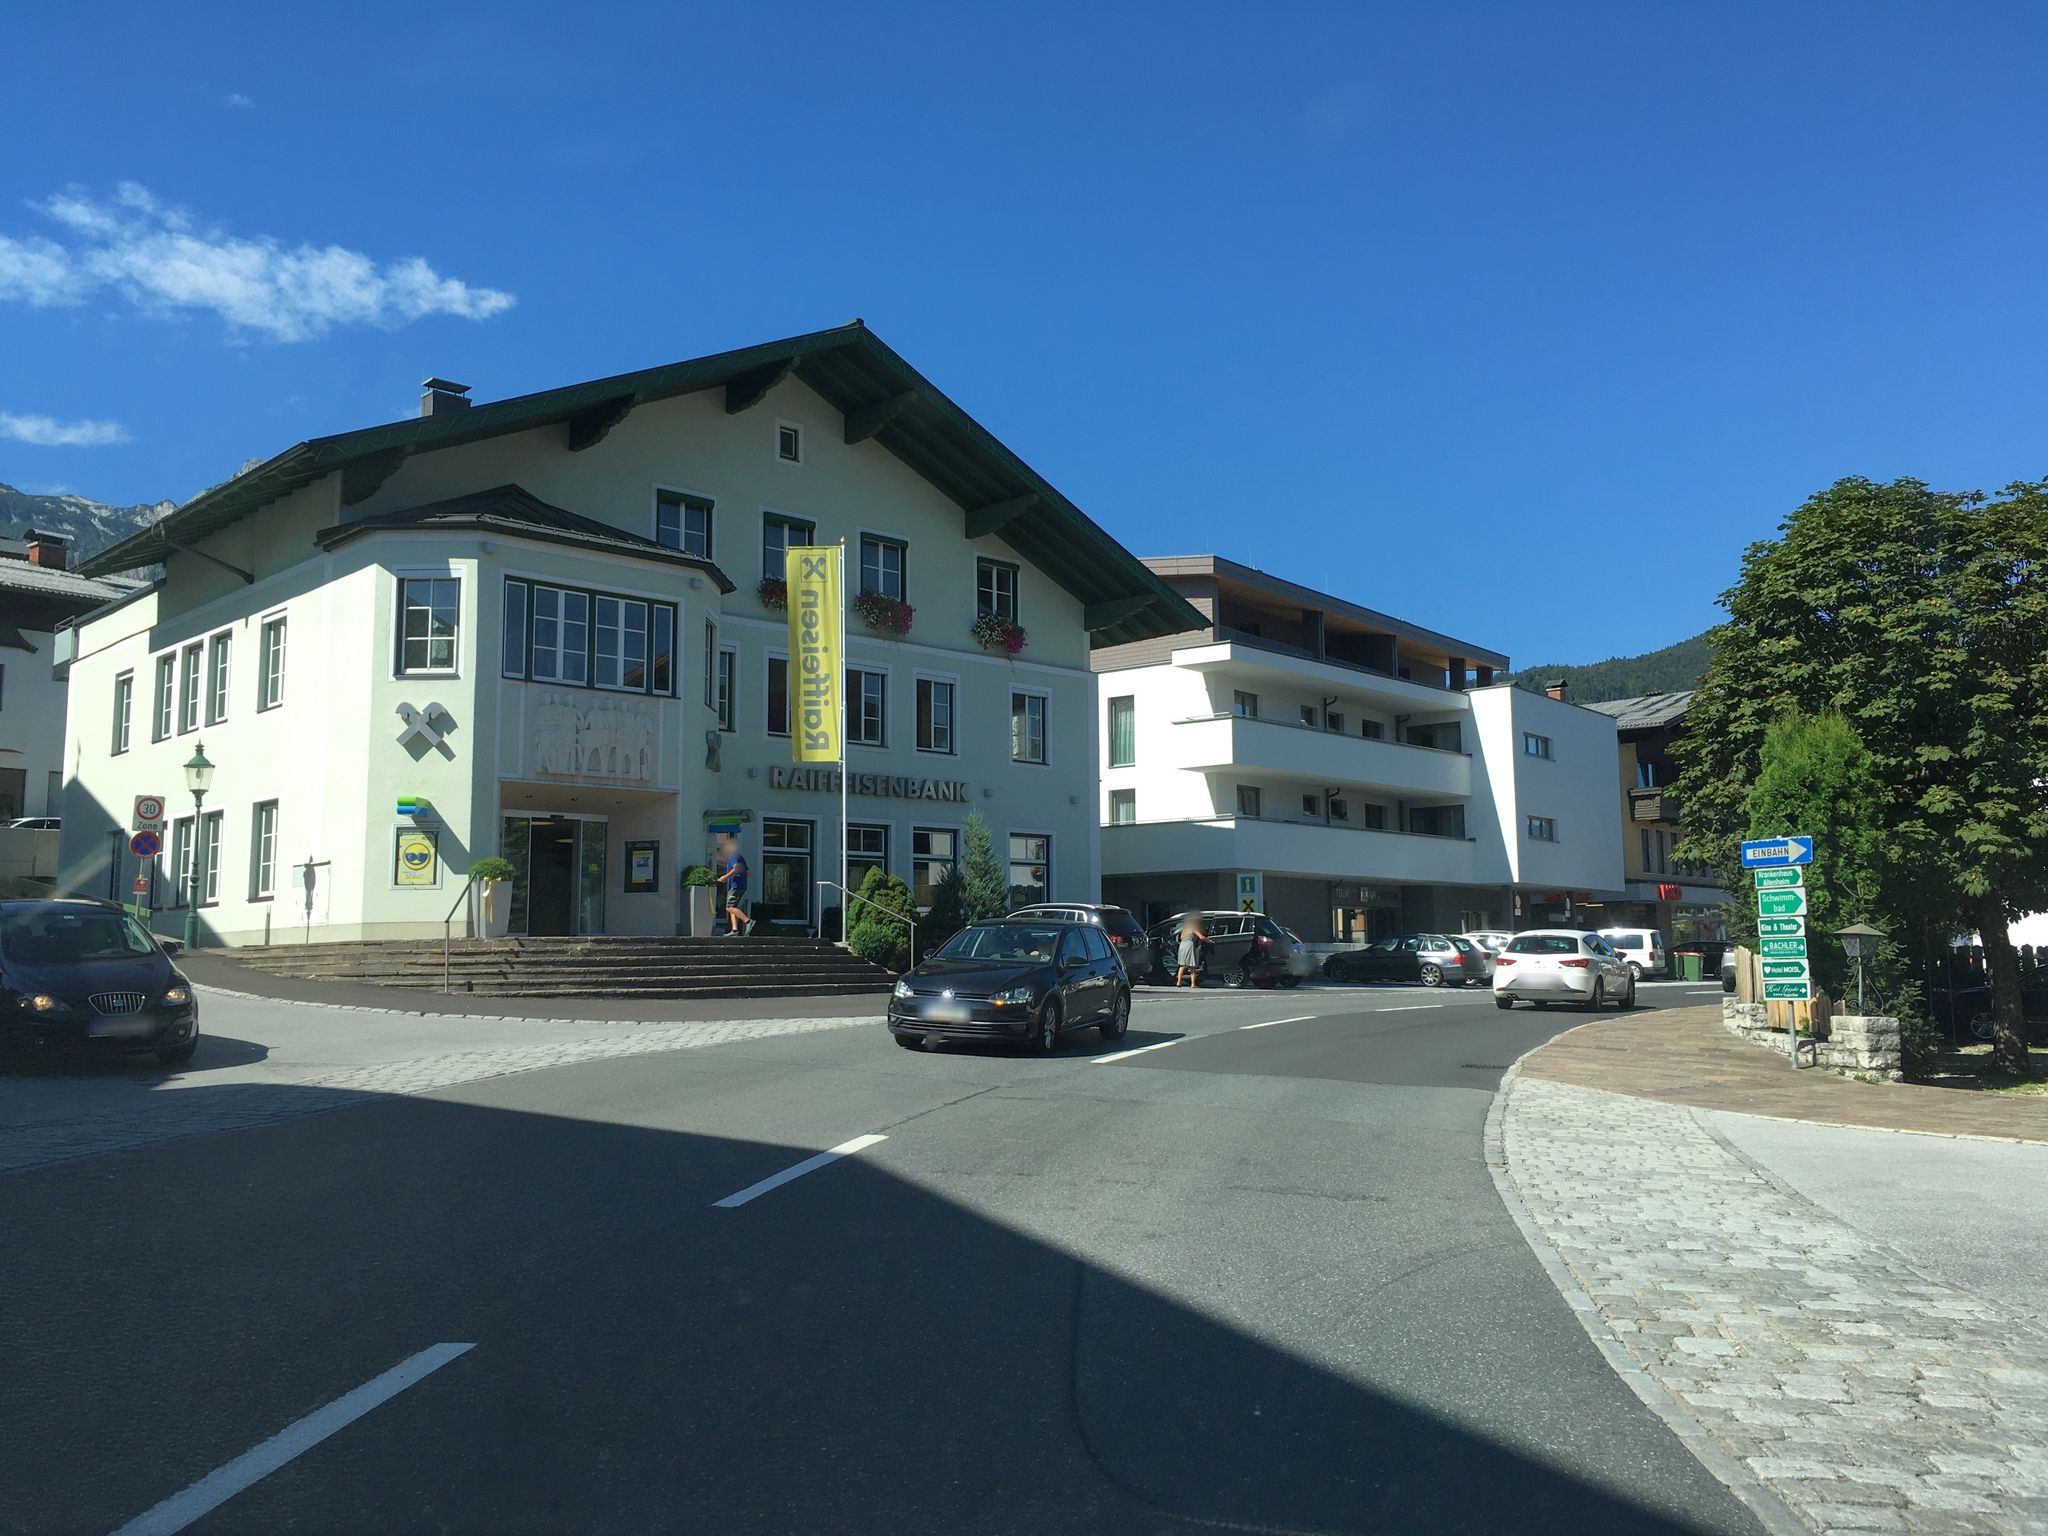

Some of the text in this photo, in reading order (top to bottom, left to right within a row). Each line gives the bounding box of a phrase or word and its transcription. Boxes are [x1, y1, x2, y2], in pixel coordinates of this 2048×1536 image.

[770, 766, 969, 802] RAIFFEISENBANK
[143, 804, 156, 815] 30
[137, 822, 158, 830] Zone
[1752, 848, 1789, 858] EINBAHN
[1758, 870, 1793, 878] Krankenhaus
[1762, 894, 1795, 902] Schwimm-
[1773, 904, 1785, 912] bad
[1773, 923, 1778, 931] &
[1779, 923, 1798, 931] Theater
